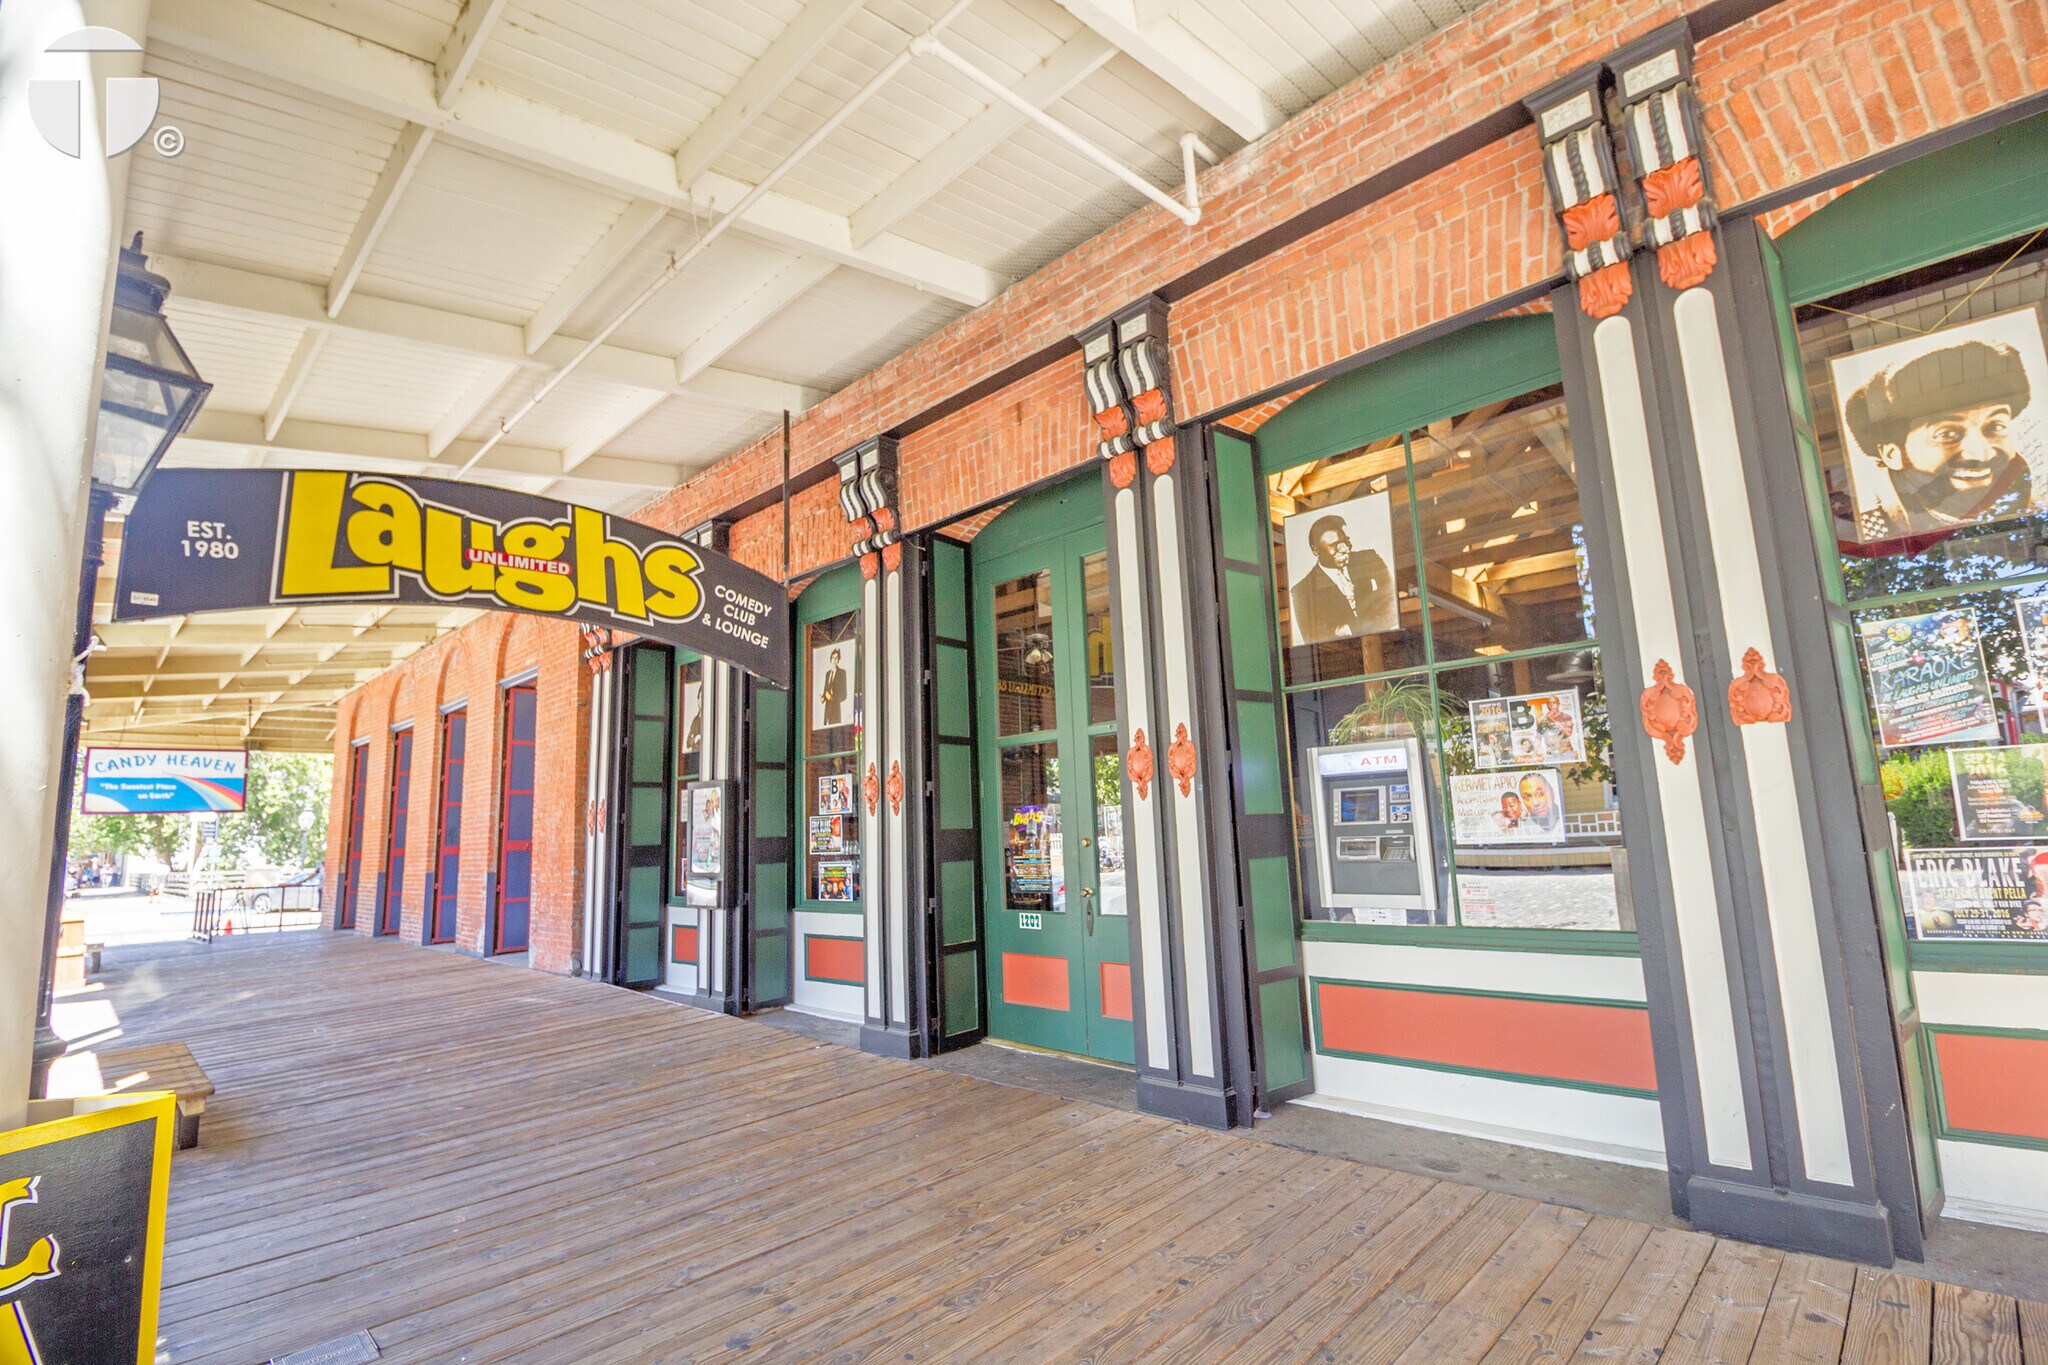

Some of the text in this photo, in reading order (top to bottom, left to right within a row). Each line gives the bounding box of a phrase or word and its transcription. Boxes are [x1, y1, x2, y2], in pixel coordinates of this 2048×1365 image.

[186, 519, 233, 540] EST.
[180, 539, 240, 560] 1980
[280, 471, 701, 619] Laughs
[468, 548, 572, 576] UNLIMITED
[714, 584, 773, 618] COMEDY
[723, 604, 757, 626] CLUB
[701, 612, 770, 649] & LOUNGE
[1879, 651, 1975, 692] KARAOKE
[1929, 669, 1979, 692] UNLIMITED
[1479, 706, 1502, 716] 2016
[95, 753, 236, 774] CANDY HEAVEN
[1360, 755, 1398, 766] ATM
[156, 783, 177, 791] Place
[1454, 775, 1517, 793] KERMET APIO
[1914, 857, 2026, 888] ERIC BLAKE
[2004, 887, 2027, 899] PELLA
[1020, 914, 1040, 928] 1207
[1953, 908, 1969, 918] JULY
[1992, 908, 2011, 918] 2016
